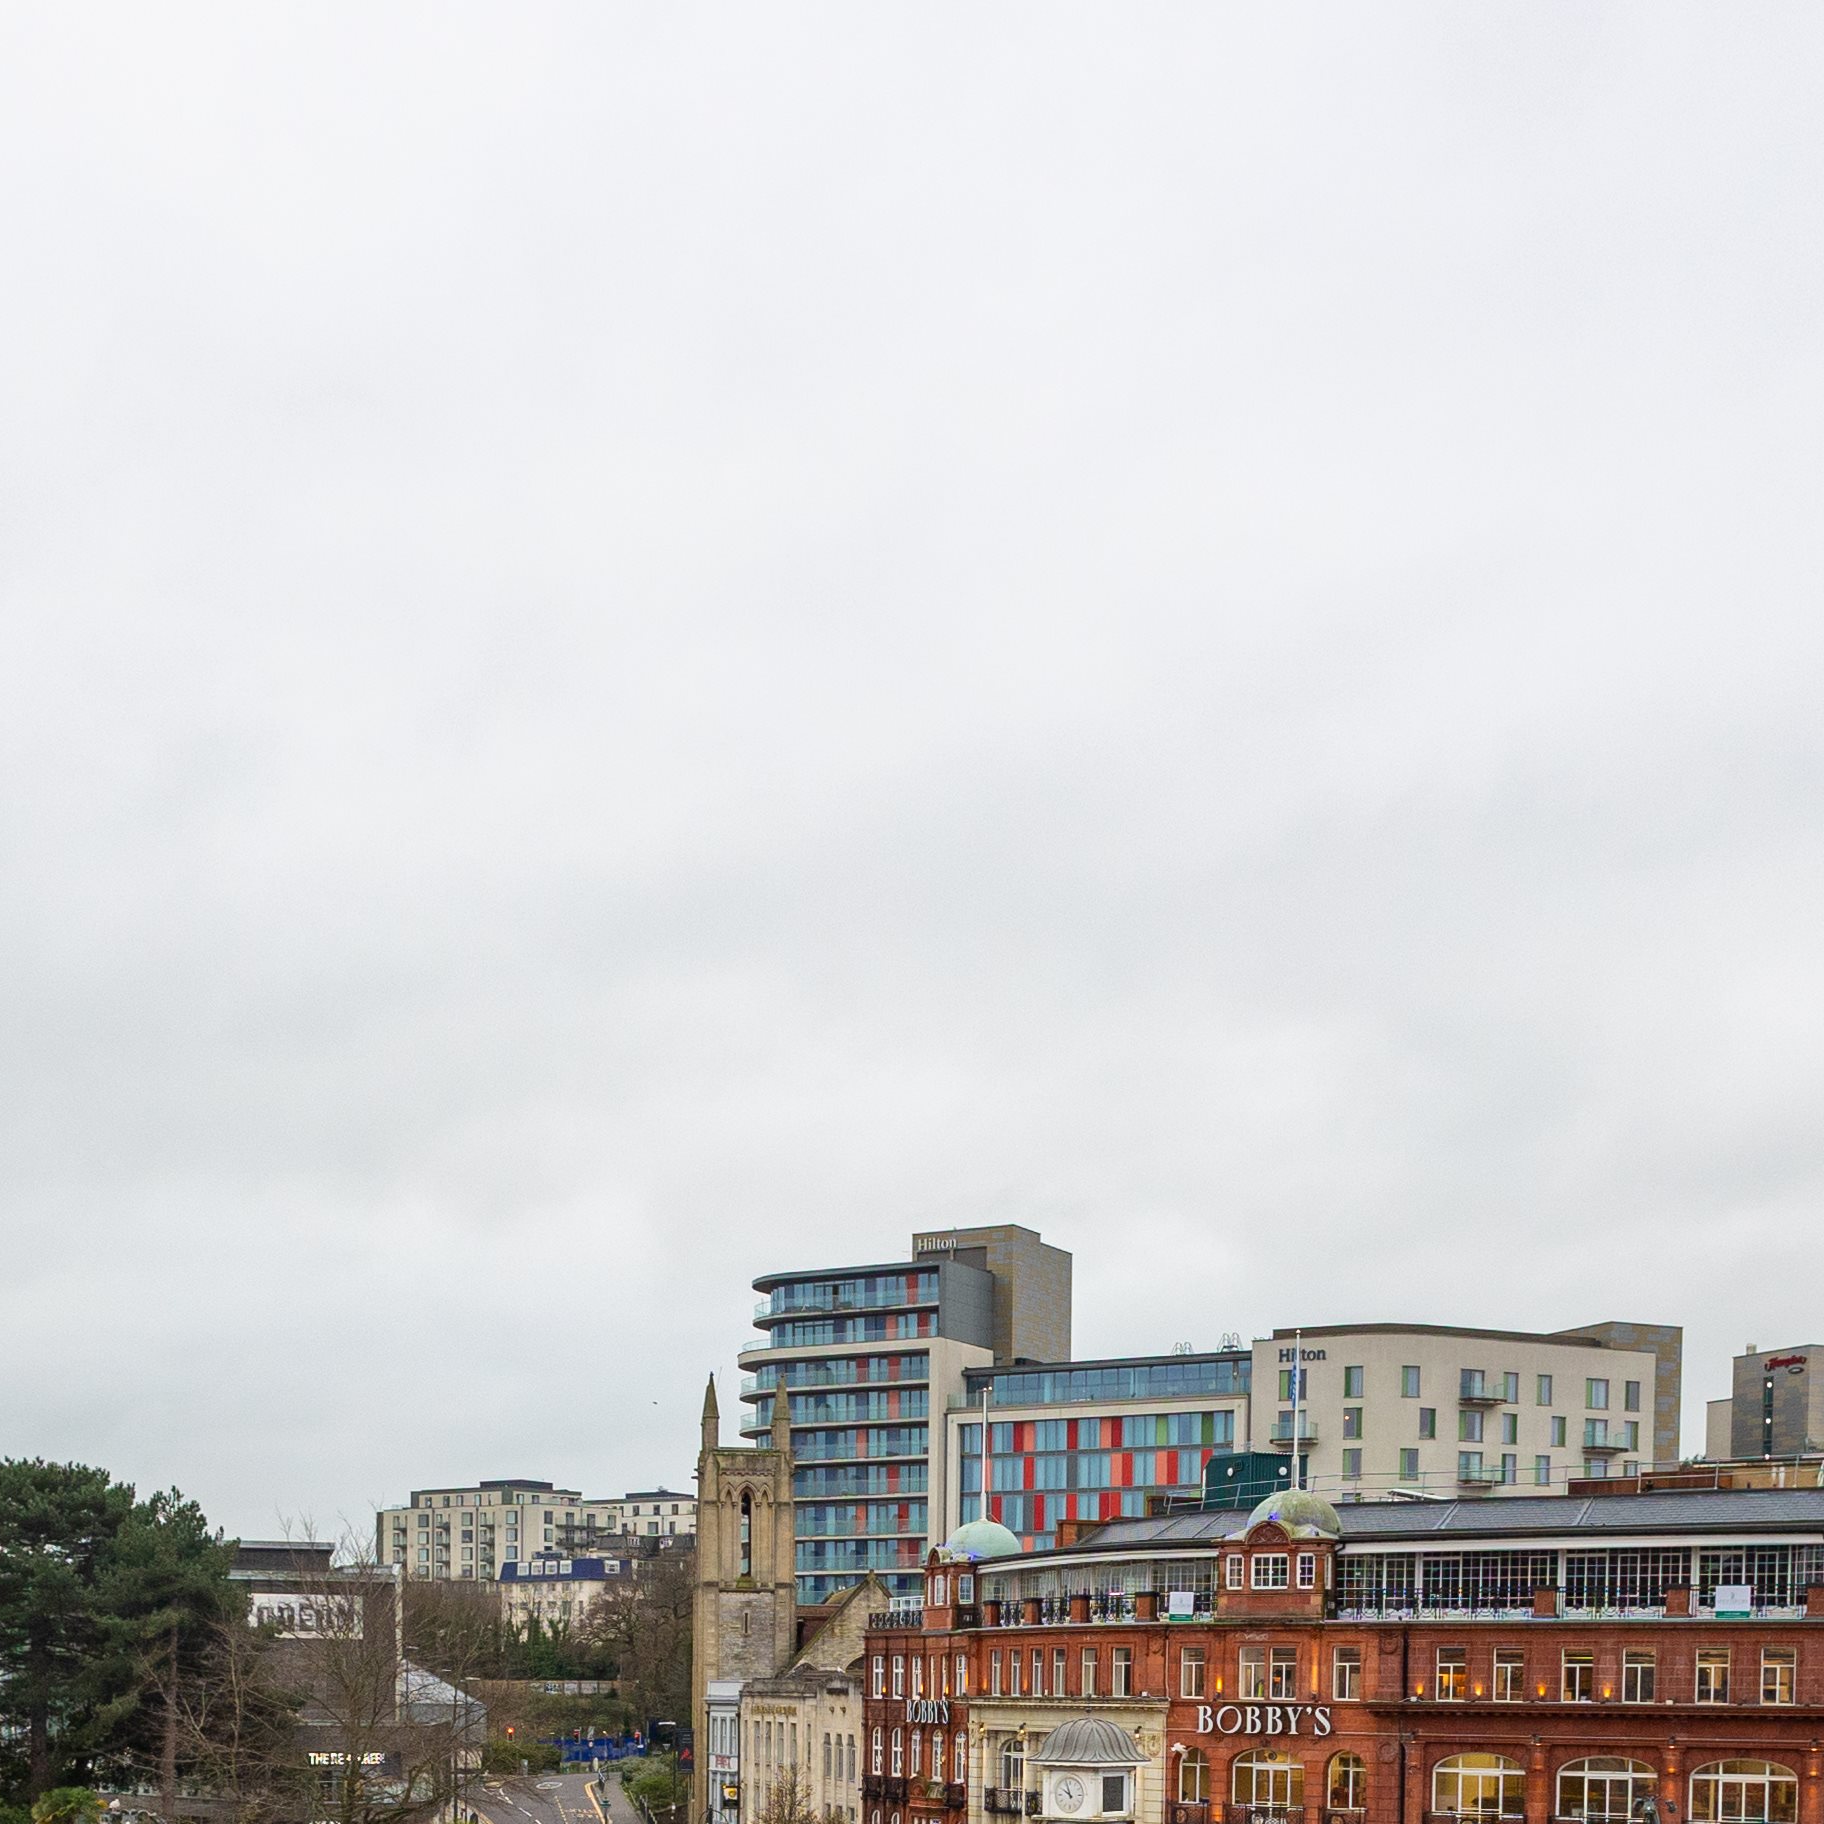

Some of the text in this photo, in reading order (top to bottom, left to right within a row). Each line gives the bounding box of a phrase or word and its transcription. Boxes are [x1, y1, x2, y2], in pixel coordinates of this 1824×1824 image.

[918, 1237, 957, 1251] Hilton
[1278, 1347, 1327, 1363] Hiton
[1764, 1354, 1808, 1372] Hampton
[906, 1699, 949, 1725] BOBBY'S
[1196, 1705, 1331, 1736] BOBBY'S
